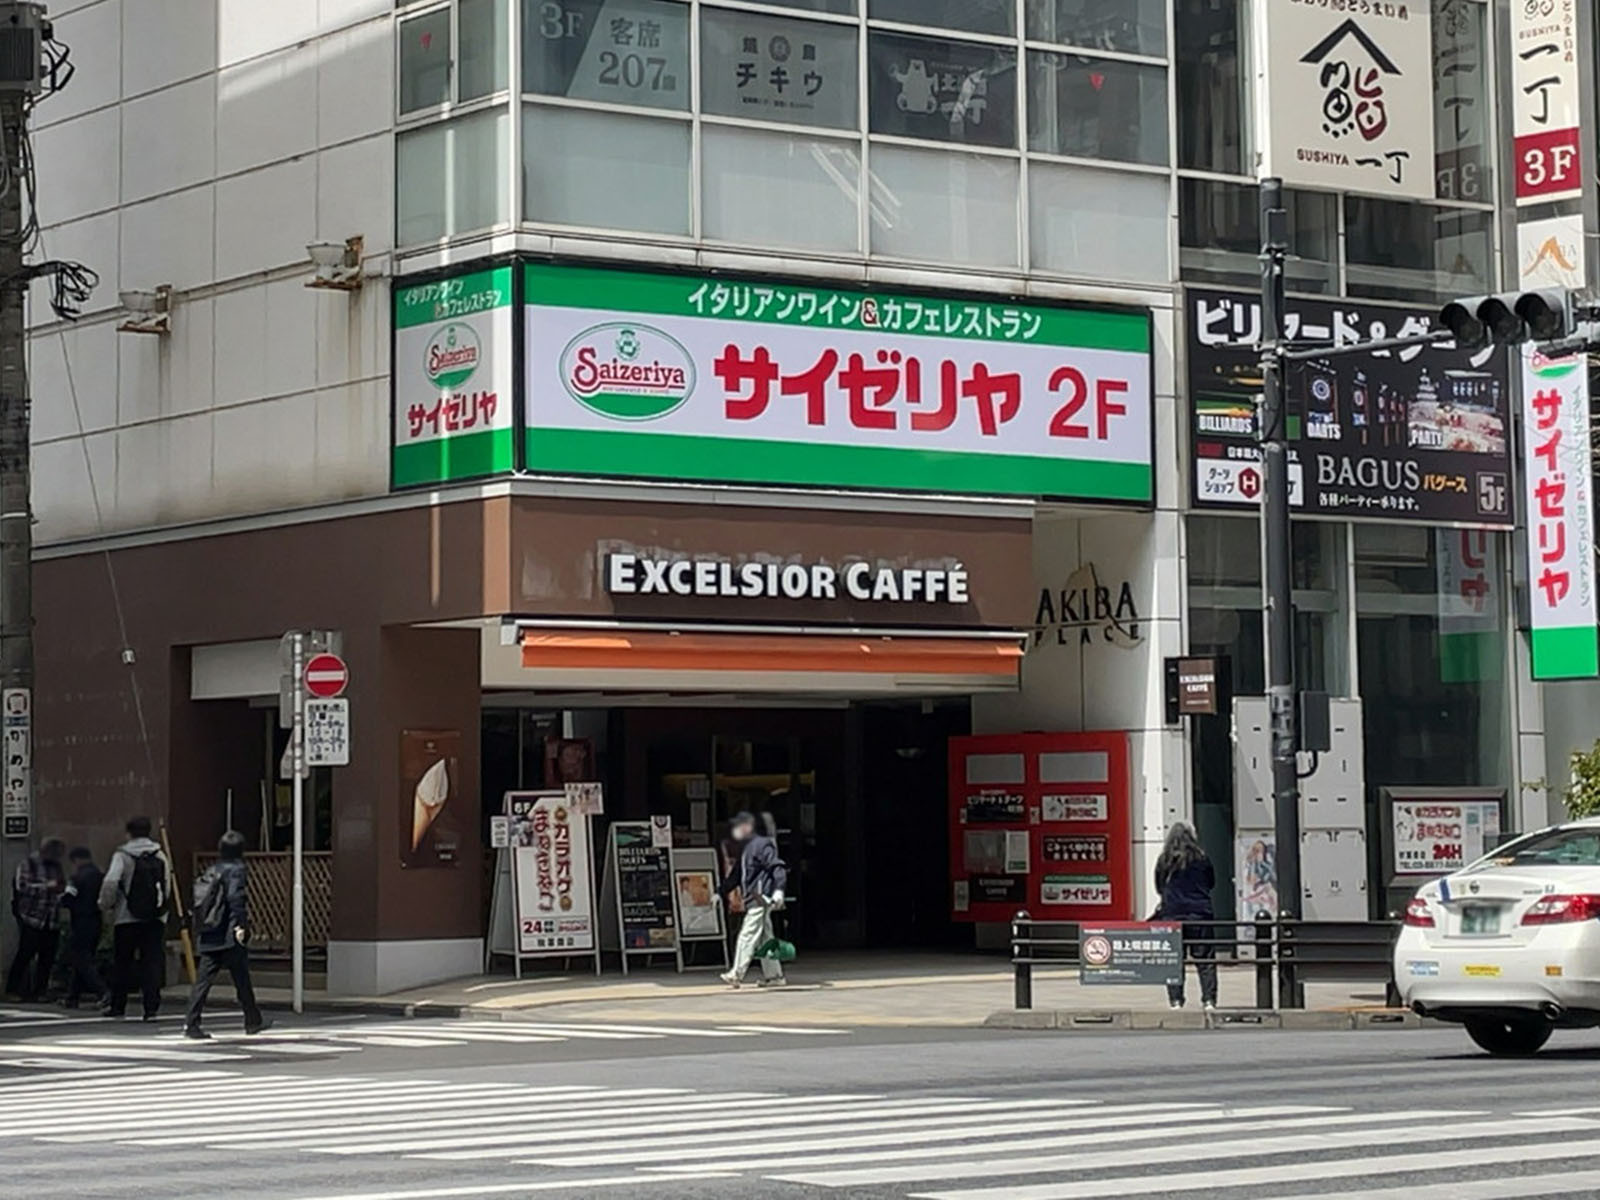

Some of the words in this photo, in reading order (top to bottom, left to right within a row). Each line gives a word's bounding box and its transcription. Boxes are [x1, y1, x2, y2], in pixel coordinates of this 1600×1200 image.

[540, 3, 583, 39] 3F
[610, 17, 661, 48] 客席
[1297, 148, 1349, 166] SUSHIYA
[1524, 146, 1576, 187] 3F
[688, 283, 1041, 339] イタリアンワイン&カフェレストラン
[574, 347, 685, 389] Saizeriya
[713, 343, 1021, 436] サイゼリヤ
[1048, 366, 1128, 440] 2F
[408, 391, 497, 438] サイゼリヤ
[1307, 422, 1341, 440] DARTS
[1411, 428, 1442, 445] PARTY
[1317, 454, 1420, 491] BAGUS
[1423, 475, 1468, 492] バグース
[1480, 476, 1505, 512] 5F
[1531, 388, 1570, 608] サイゼリヤ
[608, 553, 837, 599] EXCELSIOR
[845, 562, 969, 604] CAFFÉ
[1035, 581, 1138, 624] AKIBA
[1034, 623, 1140, 648] PLACE
[554, 822, 572, 895] カラオケ
[523, 920, 543, 934] 24
